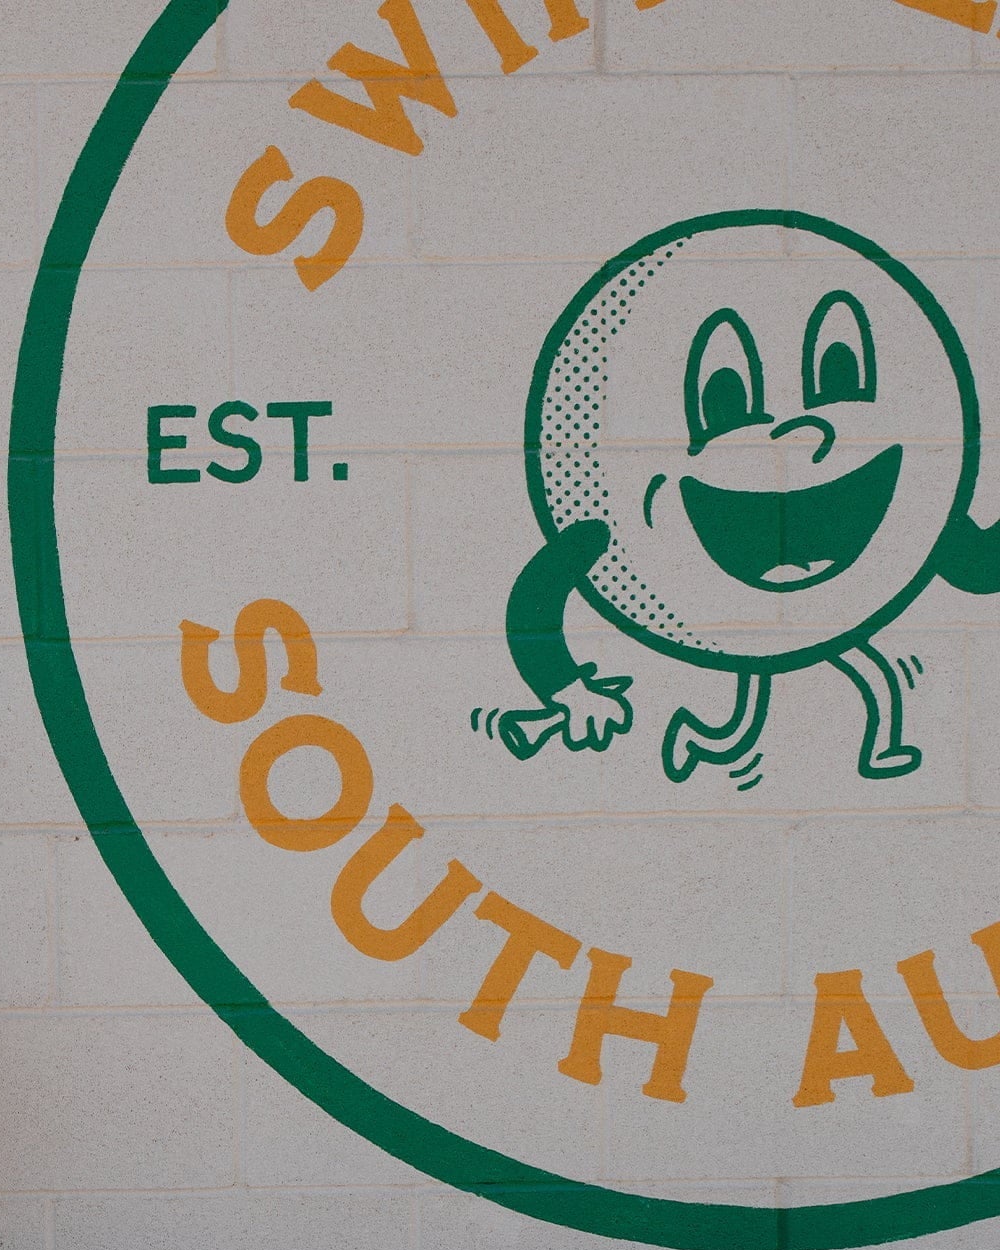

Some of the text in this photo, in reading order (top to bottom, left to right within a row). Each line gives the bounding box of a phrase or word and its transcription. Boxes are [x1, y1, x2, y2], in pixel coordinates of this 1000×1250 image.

[226, 0, 664, 291] SWI
[148, 401, 347, 483] EST.
[180, 599, 713, 1102] SOUTH
